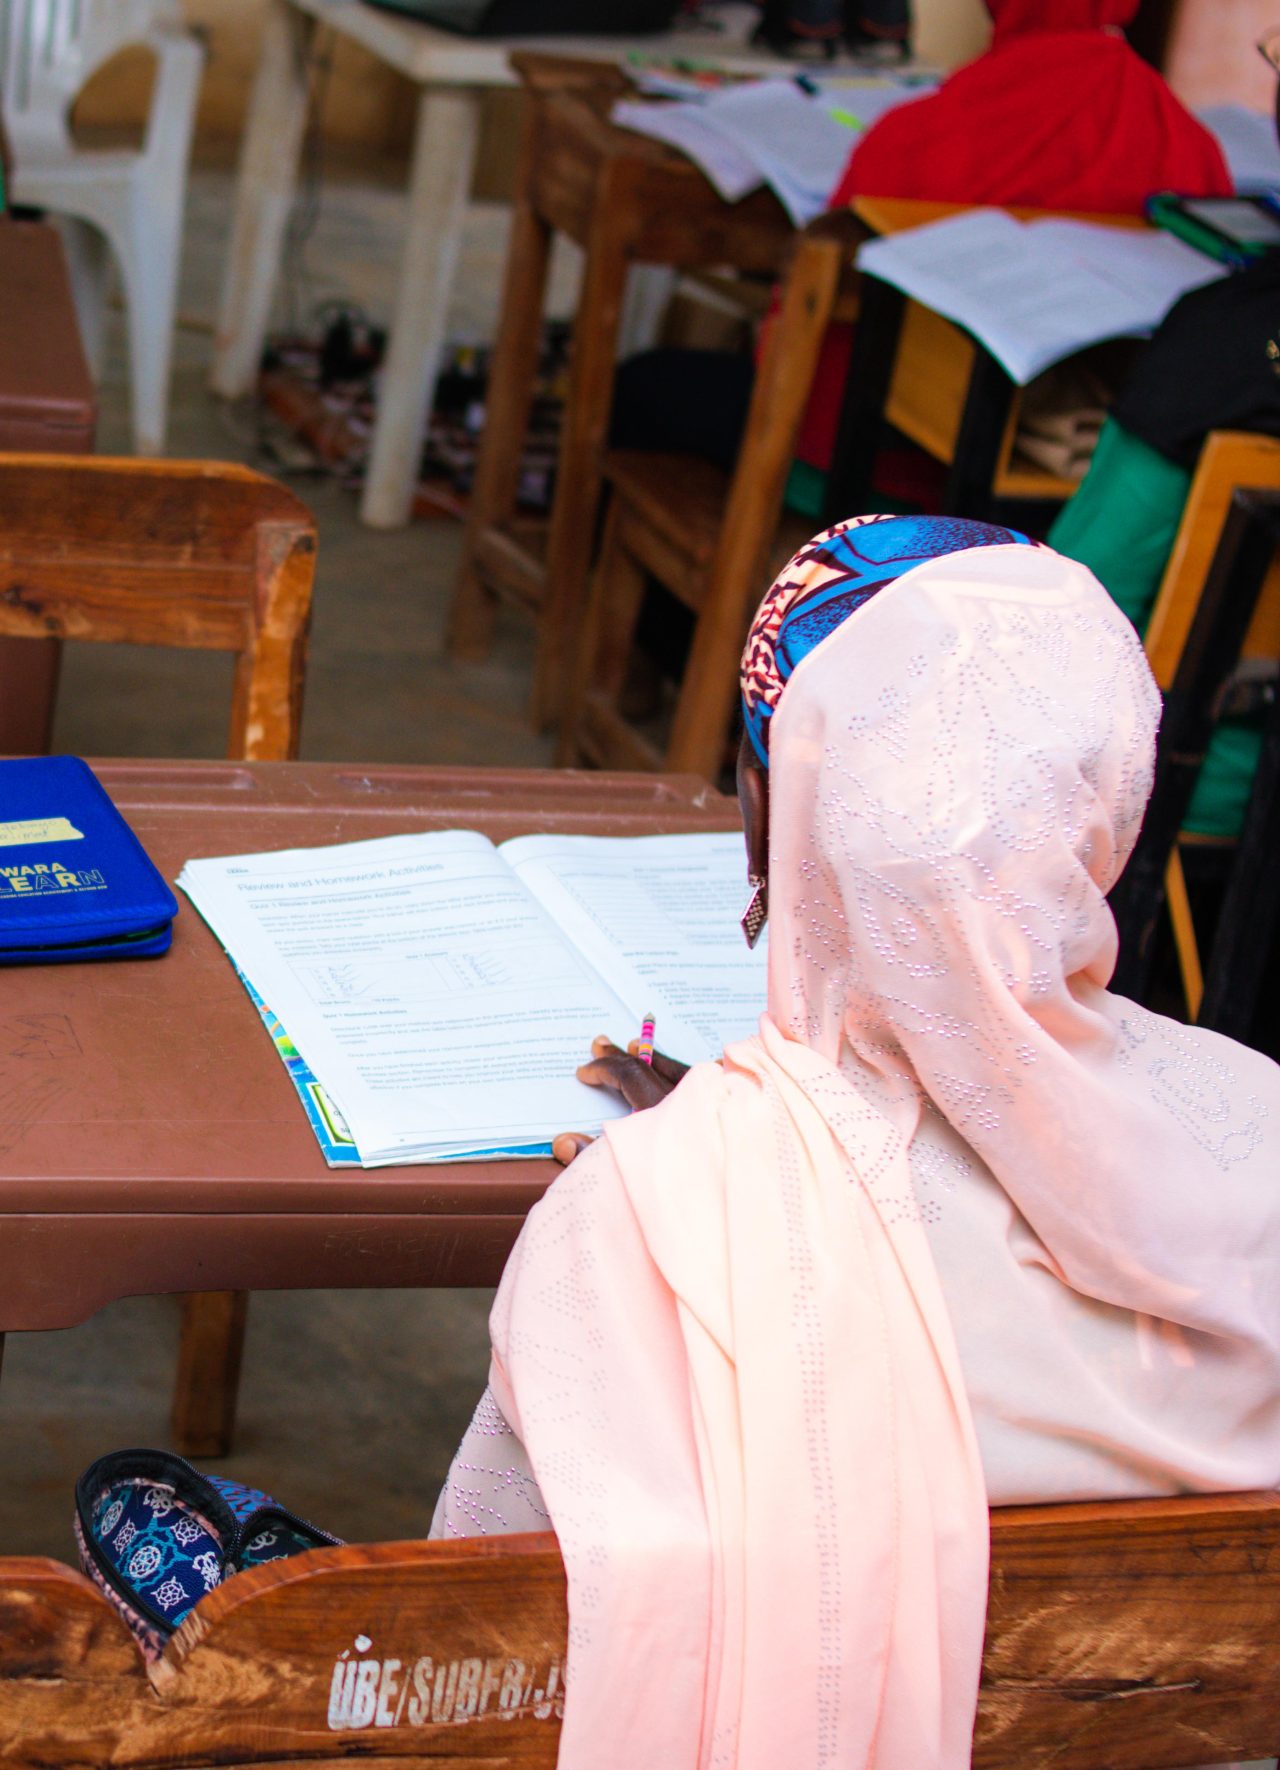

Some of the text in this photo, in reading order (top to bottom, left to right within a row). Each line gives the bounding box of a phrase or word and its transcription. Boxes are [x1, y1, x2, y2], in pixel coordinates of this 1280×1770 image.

[237, 863, 444, 892] Review and Homework Activities
